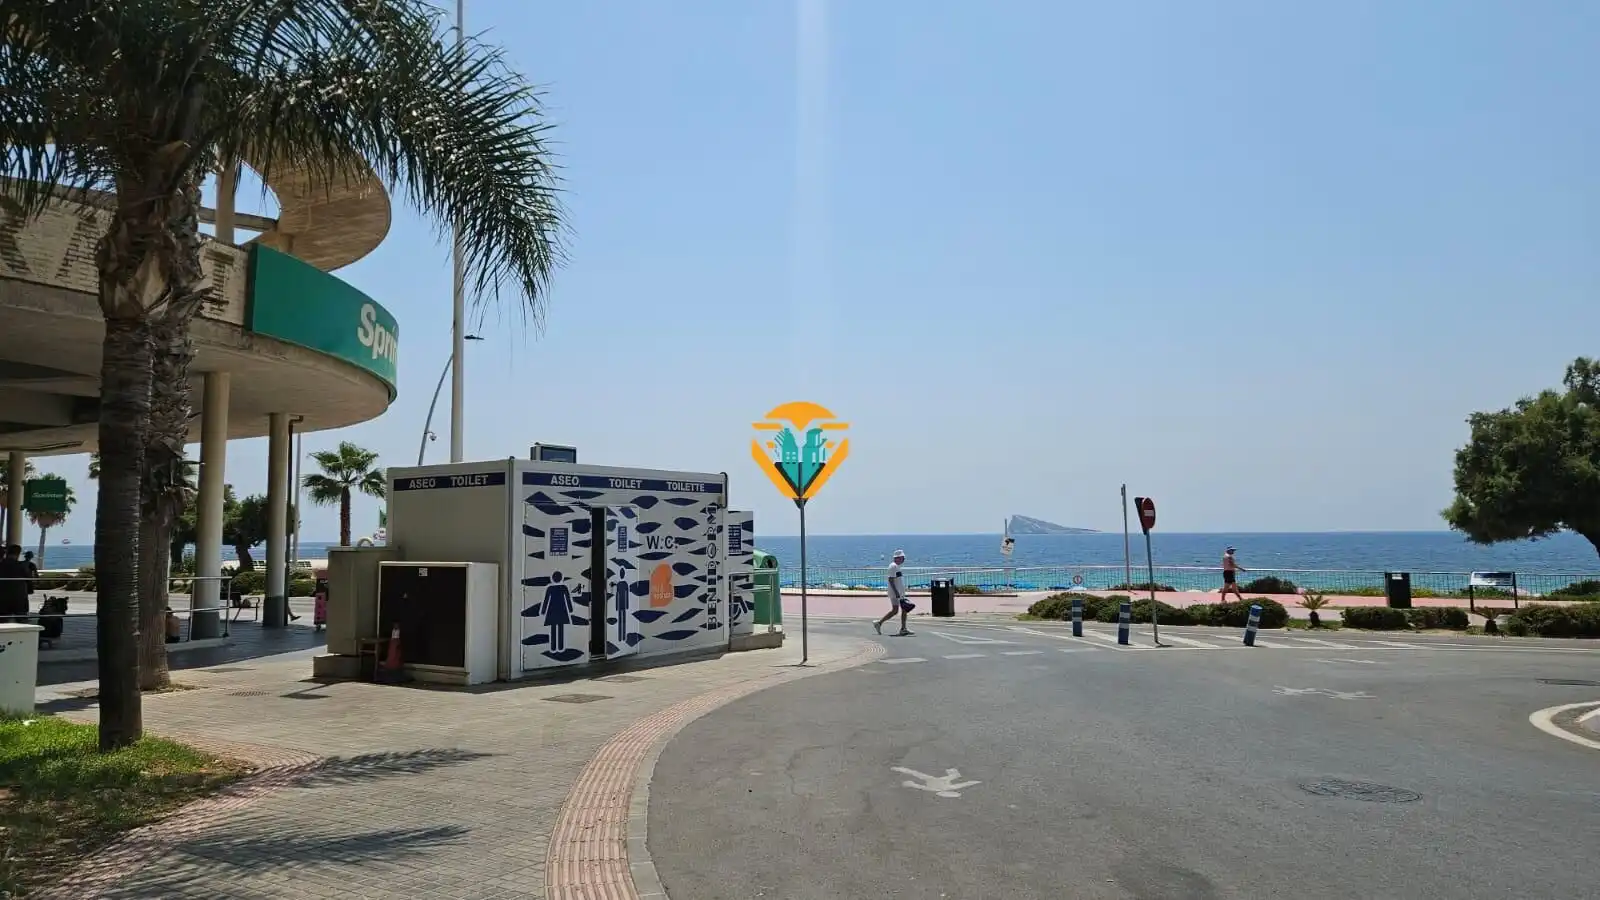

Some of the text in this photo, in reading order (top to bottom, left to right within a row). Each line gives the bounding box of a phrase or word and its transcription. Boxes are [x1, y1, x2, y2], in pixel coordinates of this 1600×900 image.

[409, 475, 489, 489] ASEO TOILET
[550, 475, 705, 492] ASEO TOILET TOILETTE
